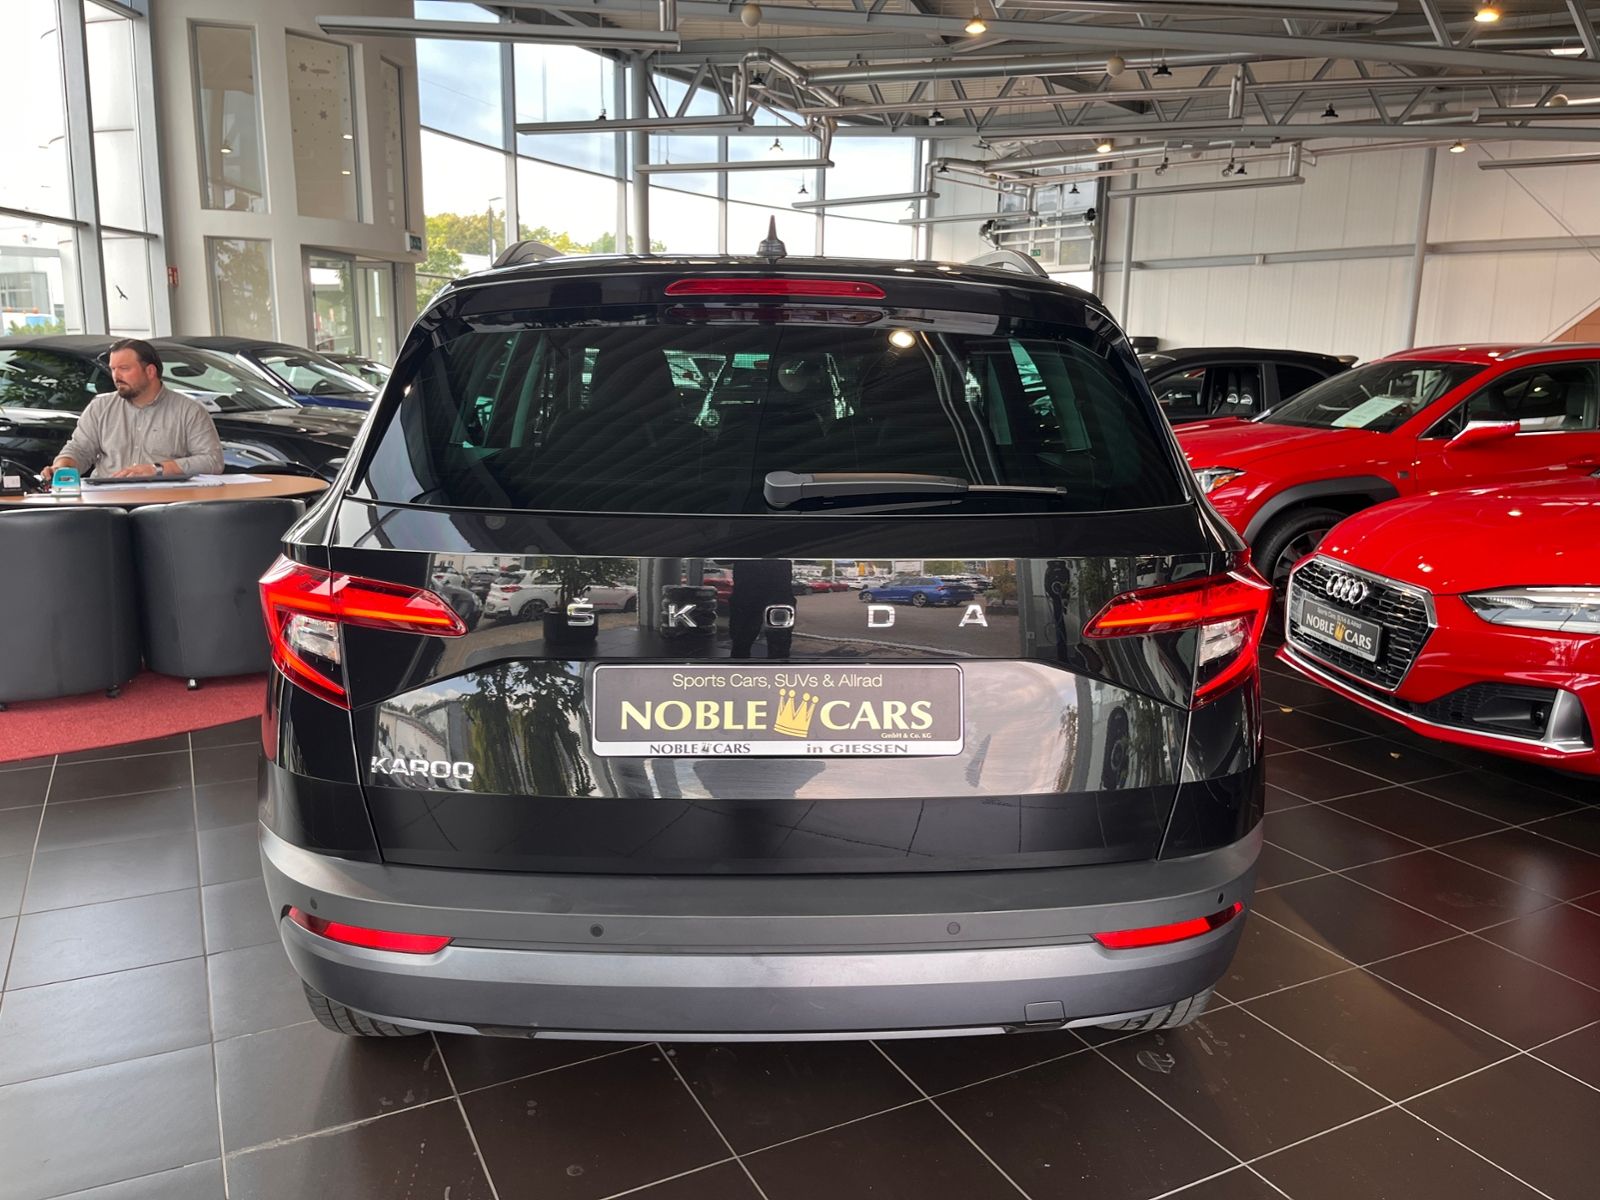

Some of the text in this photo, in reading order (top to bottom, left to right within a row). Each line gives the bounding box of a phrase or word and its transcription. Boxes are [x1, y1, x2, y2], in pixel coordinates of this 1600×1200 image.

[1306, 613, 1334, 635] NOBLE
[1345, 630, 1372, 650] CARS
[672, 673, 883, 690] Sports Cars, SUVs & Allrad
[620, 700, 933, 731] NOBLE CARS
[649, 743, 908, 754] NOBLE CARS in GIESSEN
[369, 755, 476, 782] KAROQ
